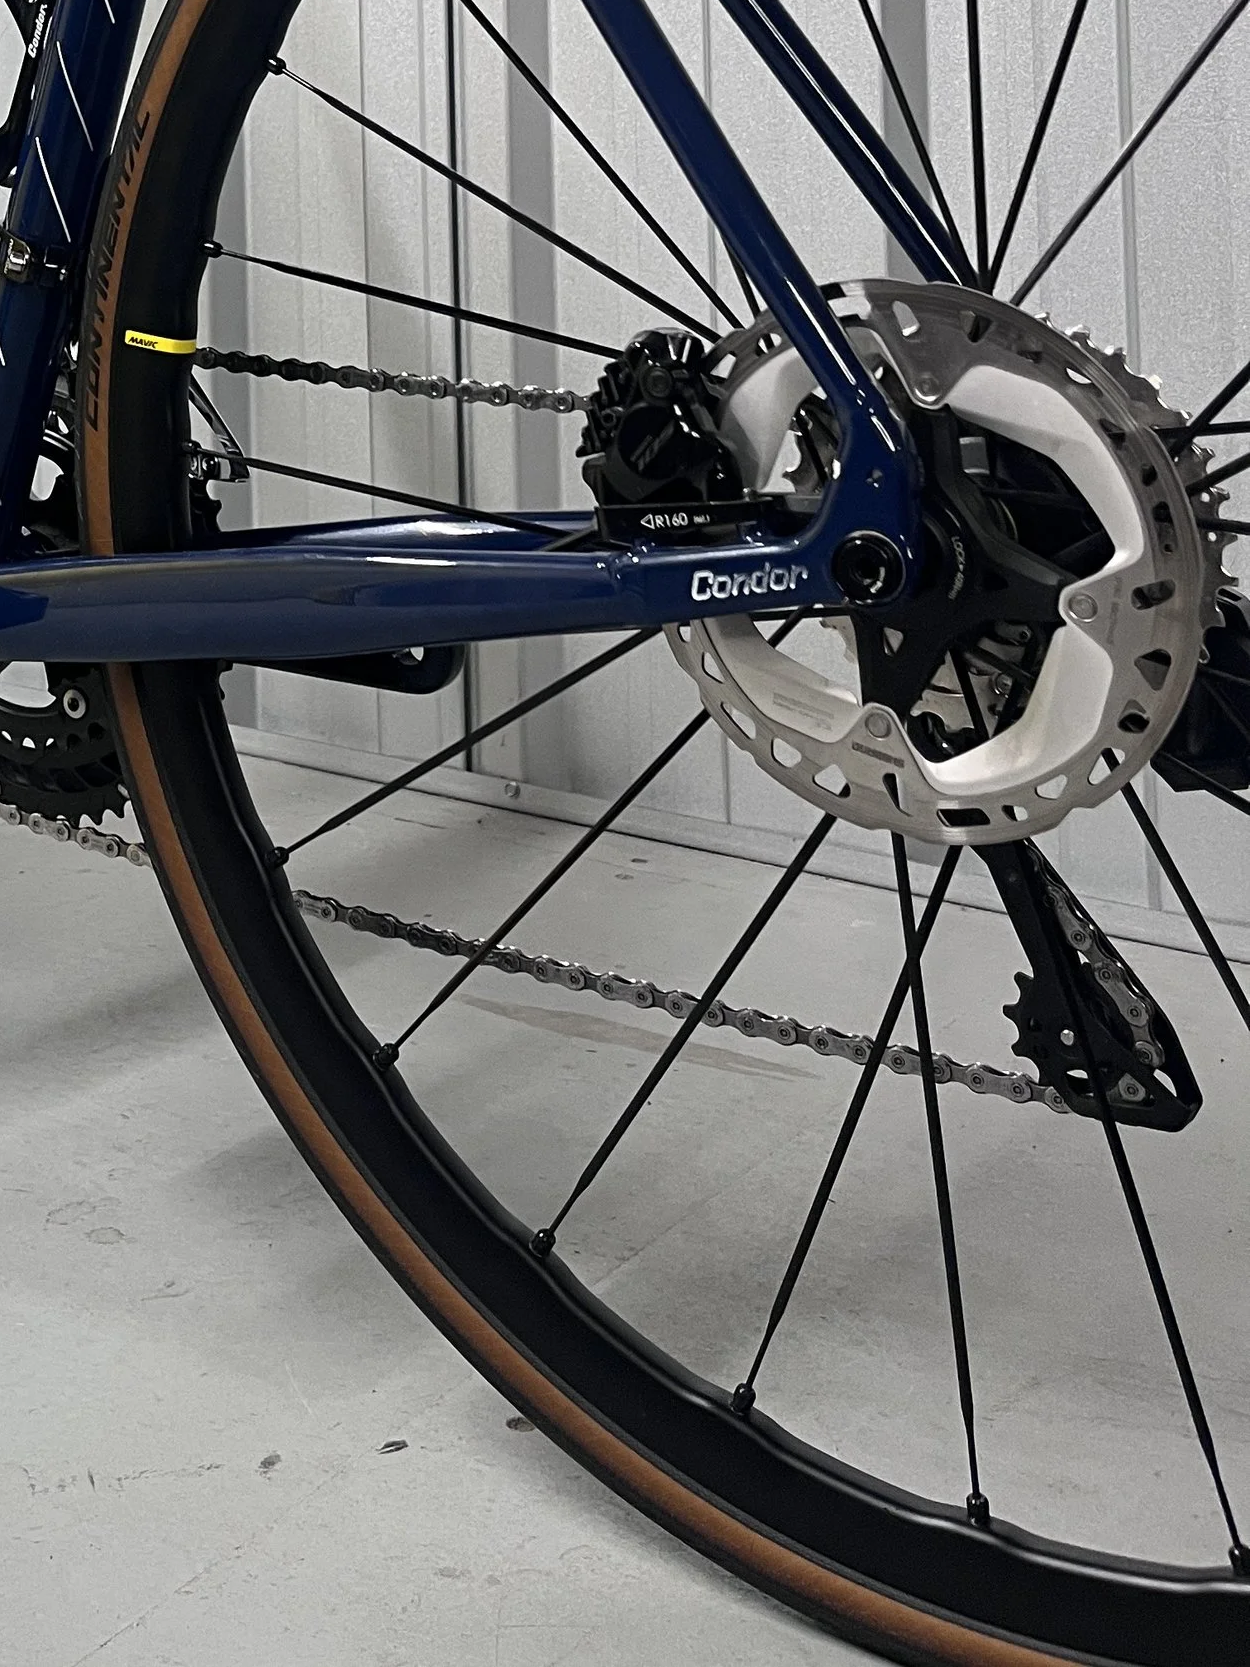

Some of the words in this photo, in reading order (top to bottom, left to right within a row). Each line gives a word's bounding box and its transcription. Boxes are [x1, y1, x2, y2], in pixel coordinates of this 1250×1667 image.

[27, 3, 48, 59] Condor
[128, 336, 158, 349] MAVIC
[655, 511, 689, 529] R160
[690, 561, 810, 602] Condor
